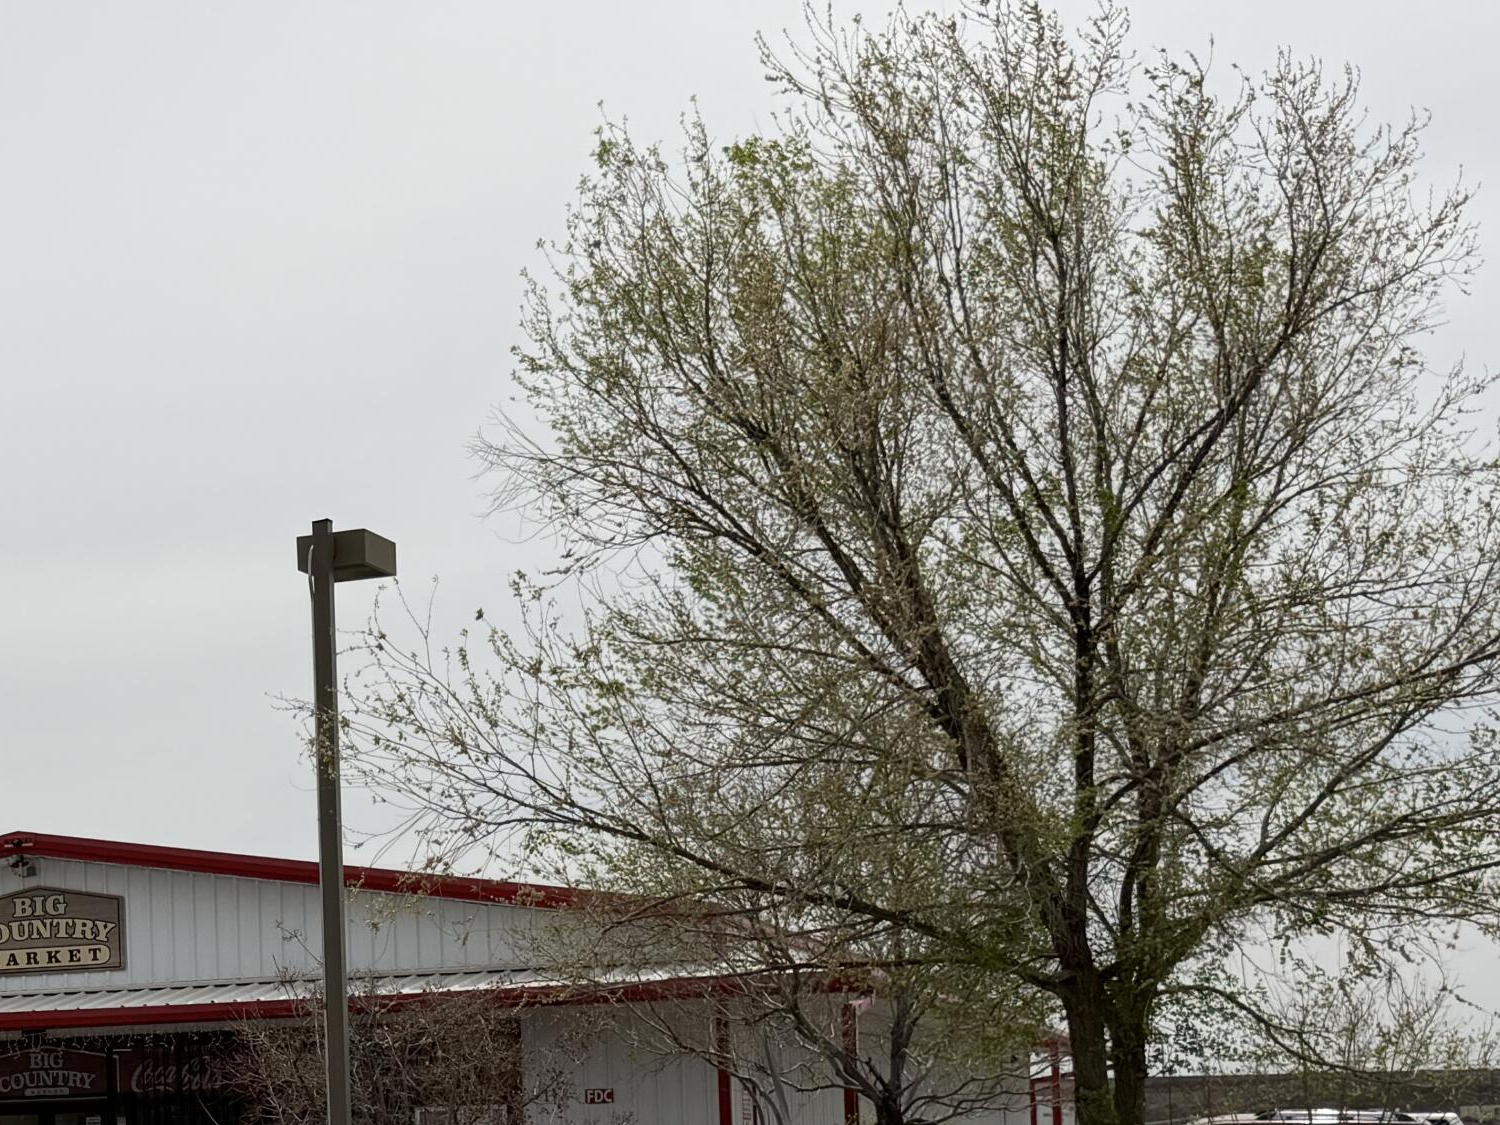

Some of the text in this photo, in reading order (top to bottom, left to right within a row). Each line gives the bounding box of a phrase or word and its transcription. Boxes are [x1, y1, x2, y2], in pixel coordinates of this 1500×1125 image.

[13, 895, 68, 918] BIG
[29, 1052, 64, 1069] BIG
[586, 1089, 613, 1104] FDC
